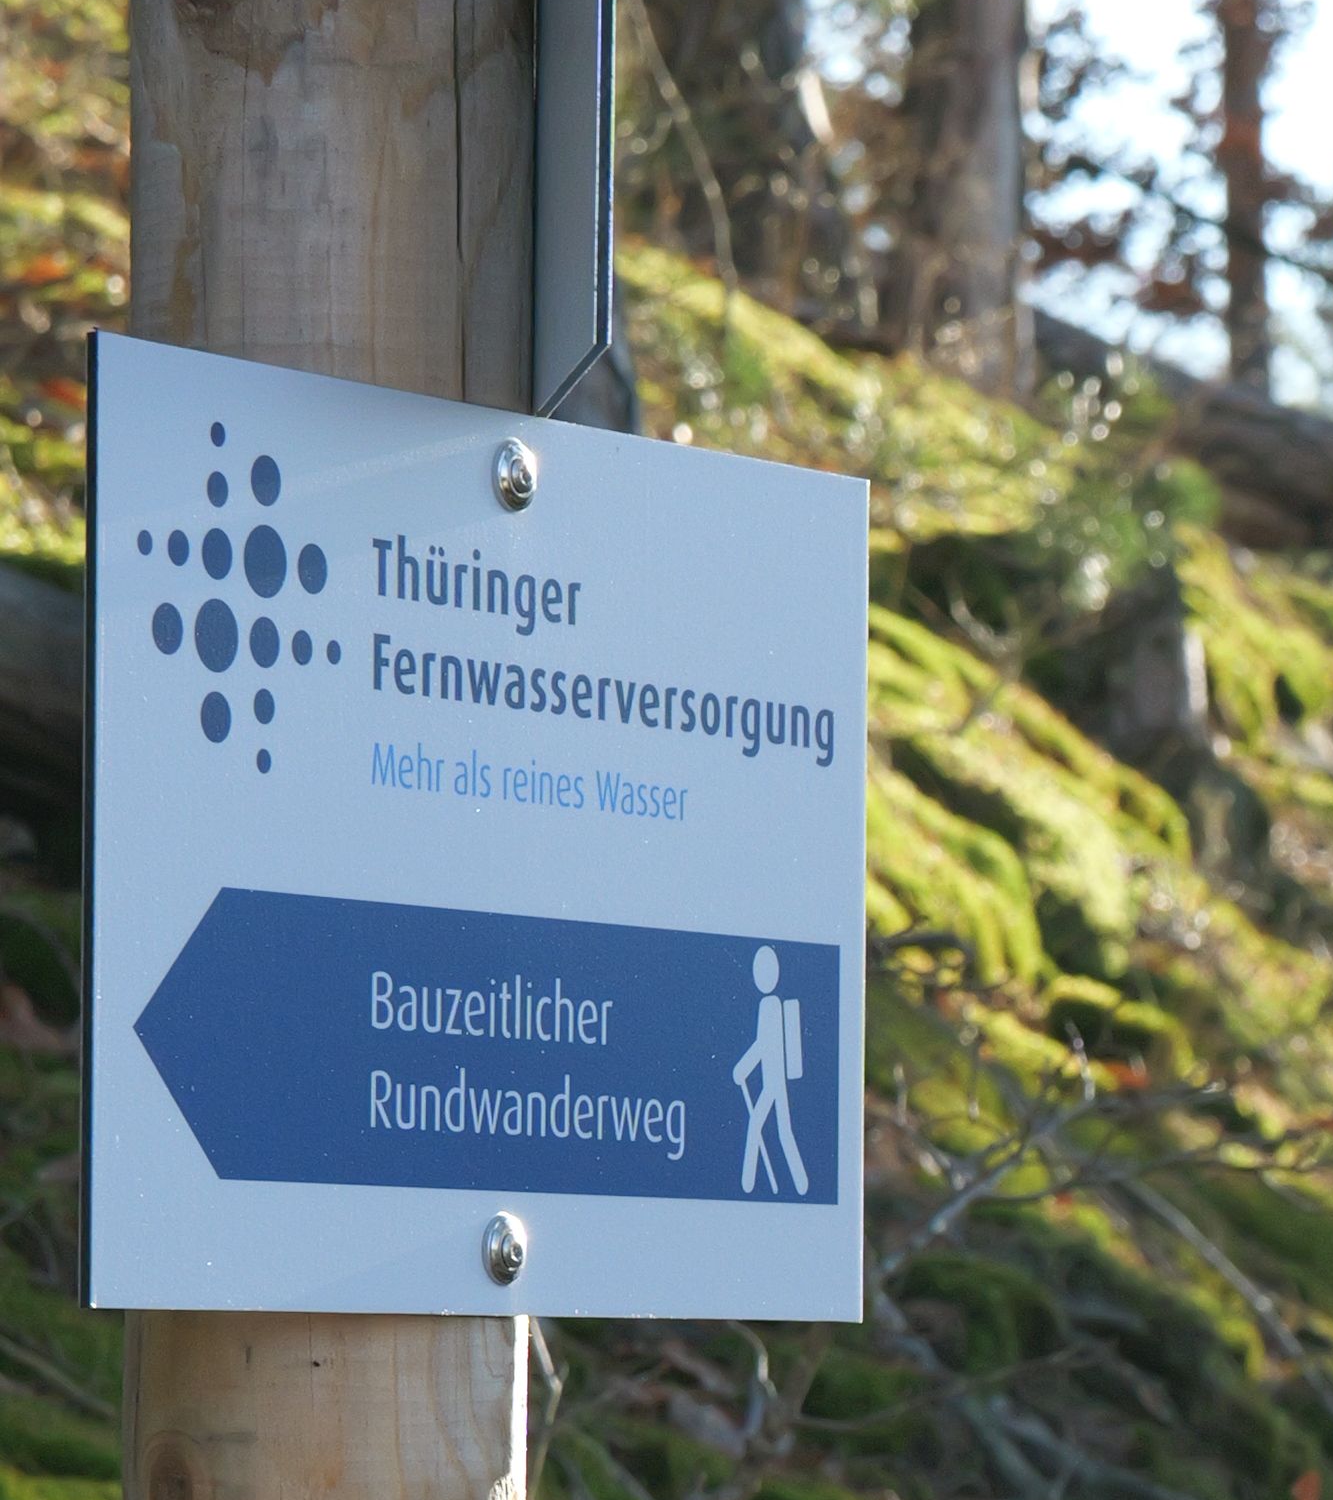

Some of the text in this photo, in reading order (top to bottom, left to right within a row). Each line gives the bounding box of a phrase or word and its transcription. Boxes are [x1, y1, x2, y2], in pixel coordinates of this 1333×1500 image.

[373, 535, 581, 635] Thüringer
[373, 633, 835, 767] Fernwasserversorgung
[372, 742, 688, 821] Mehr als reines Wasser
[371, 971, 613, 1045] Bauzeitlicher
[369, 1067, 687, 1161] Rundwanderweg
